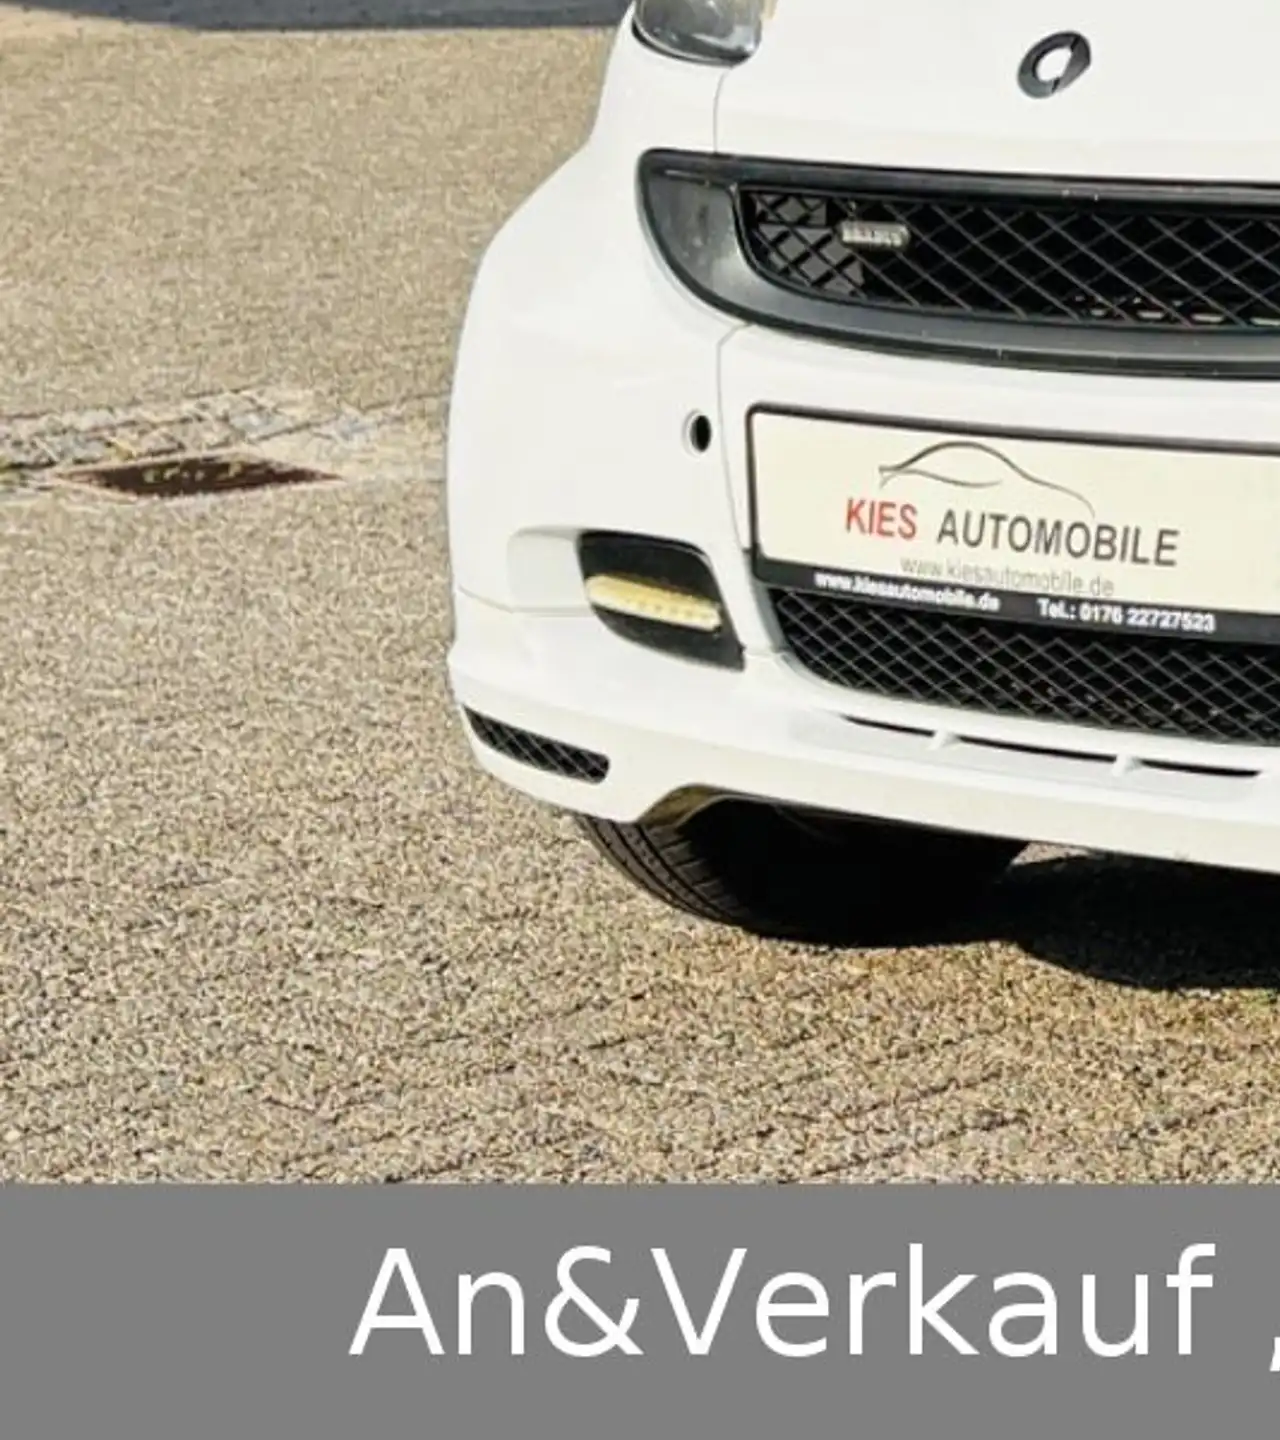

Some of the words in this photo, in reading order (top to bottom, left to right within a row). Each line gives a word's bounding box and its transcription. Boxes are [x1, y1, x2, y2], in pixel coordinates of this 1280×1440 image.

[845, 497, 918, 540] KIES
[937, 508, 1180, 567] AUTOMOBILE
[902, 558, 1115, 598] www.kiesautomobile.de
